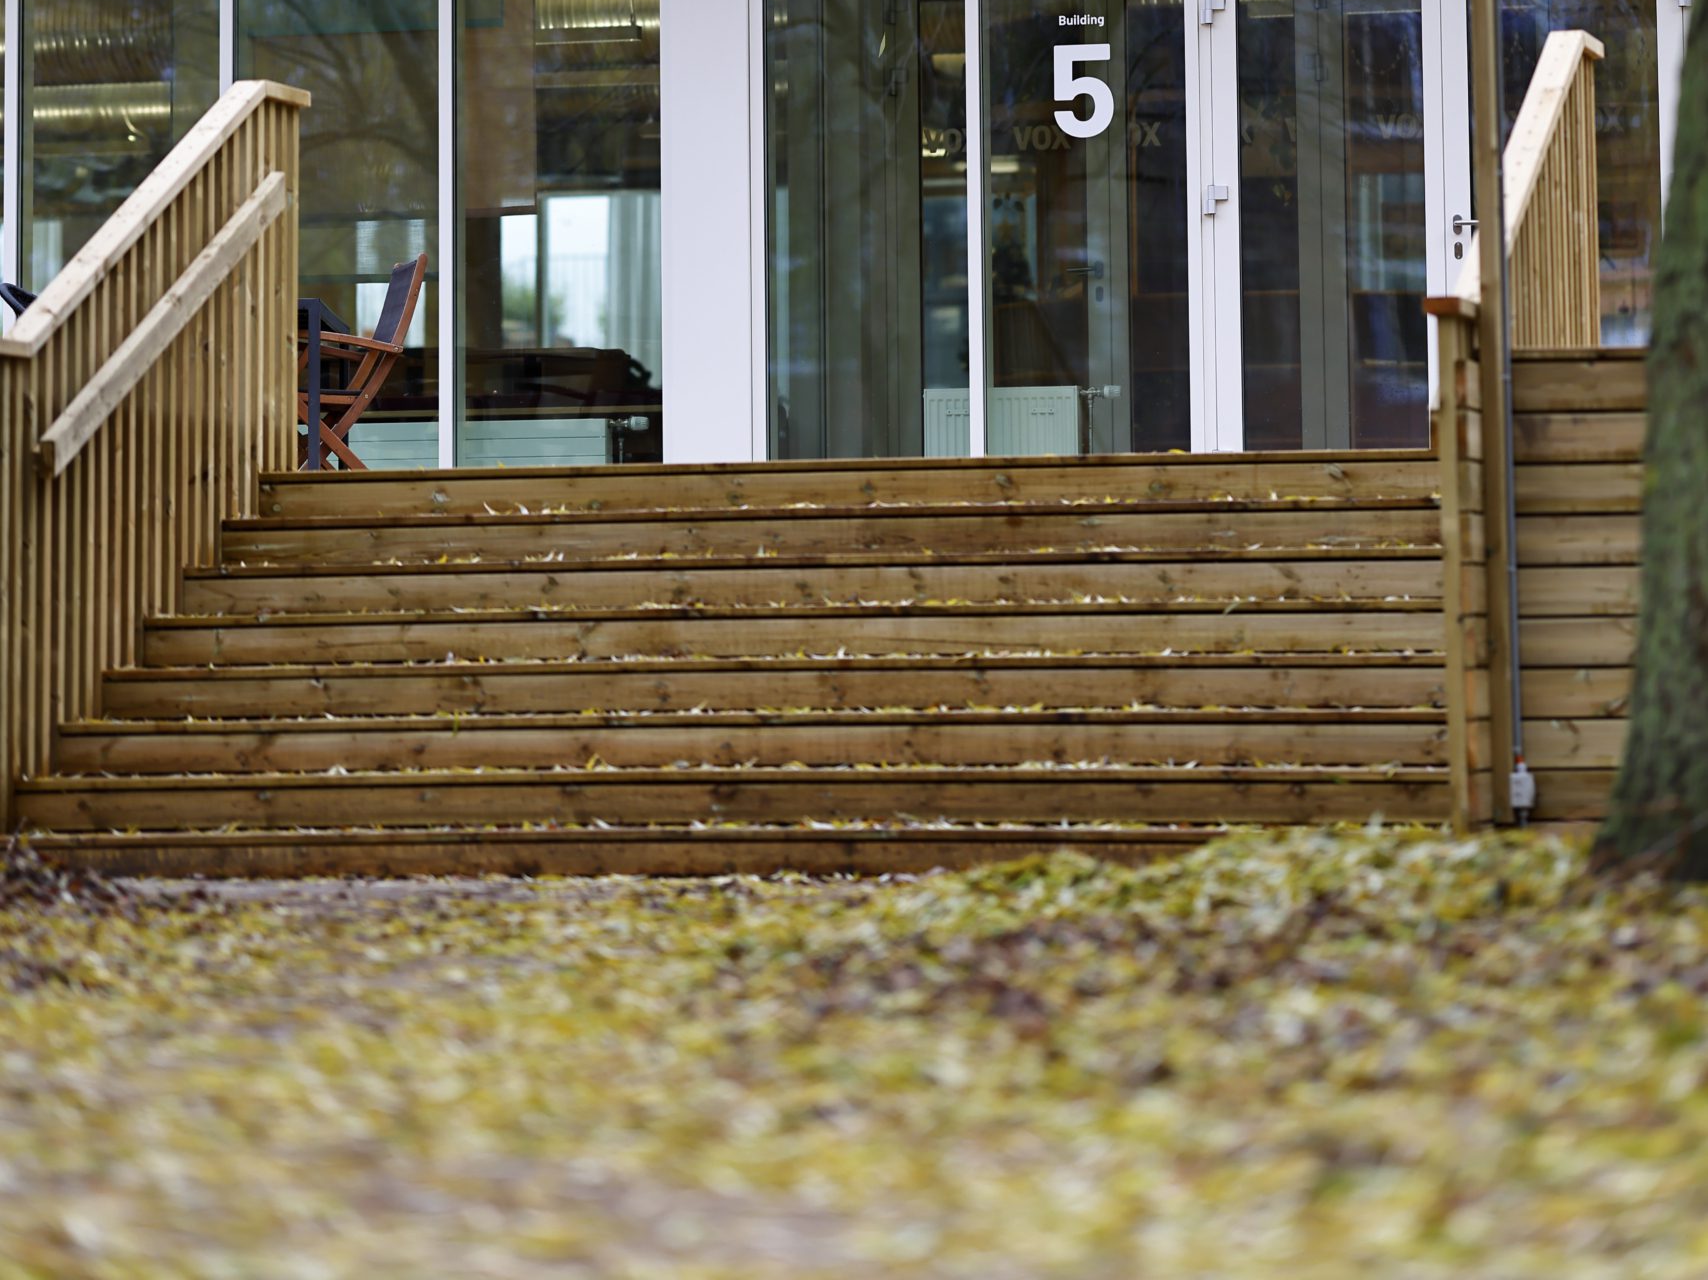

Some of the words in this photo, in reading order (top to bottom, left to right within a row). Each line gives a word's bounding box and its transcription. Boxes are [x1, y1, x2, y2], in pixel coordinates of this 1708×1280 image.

[1058, 14, 1105, 27] Building
[1053, 43, 1115, 138] 5
[1127, 121, 1161, 147] OX
